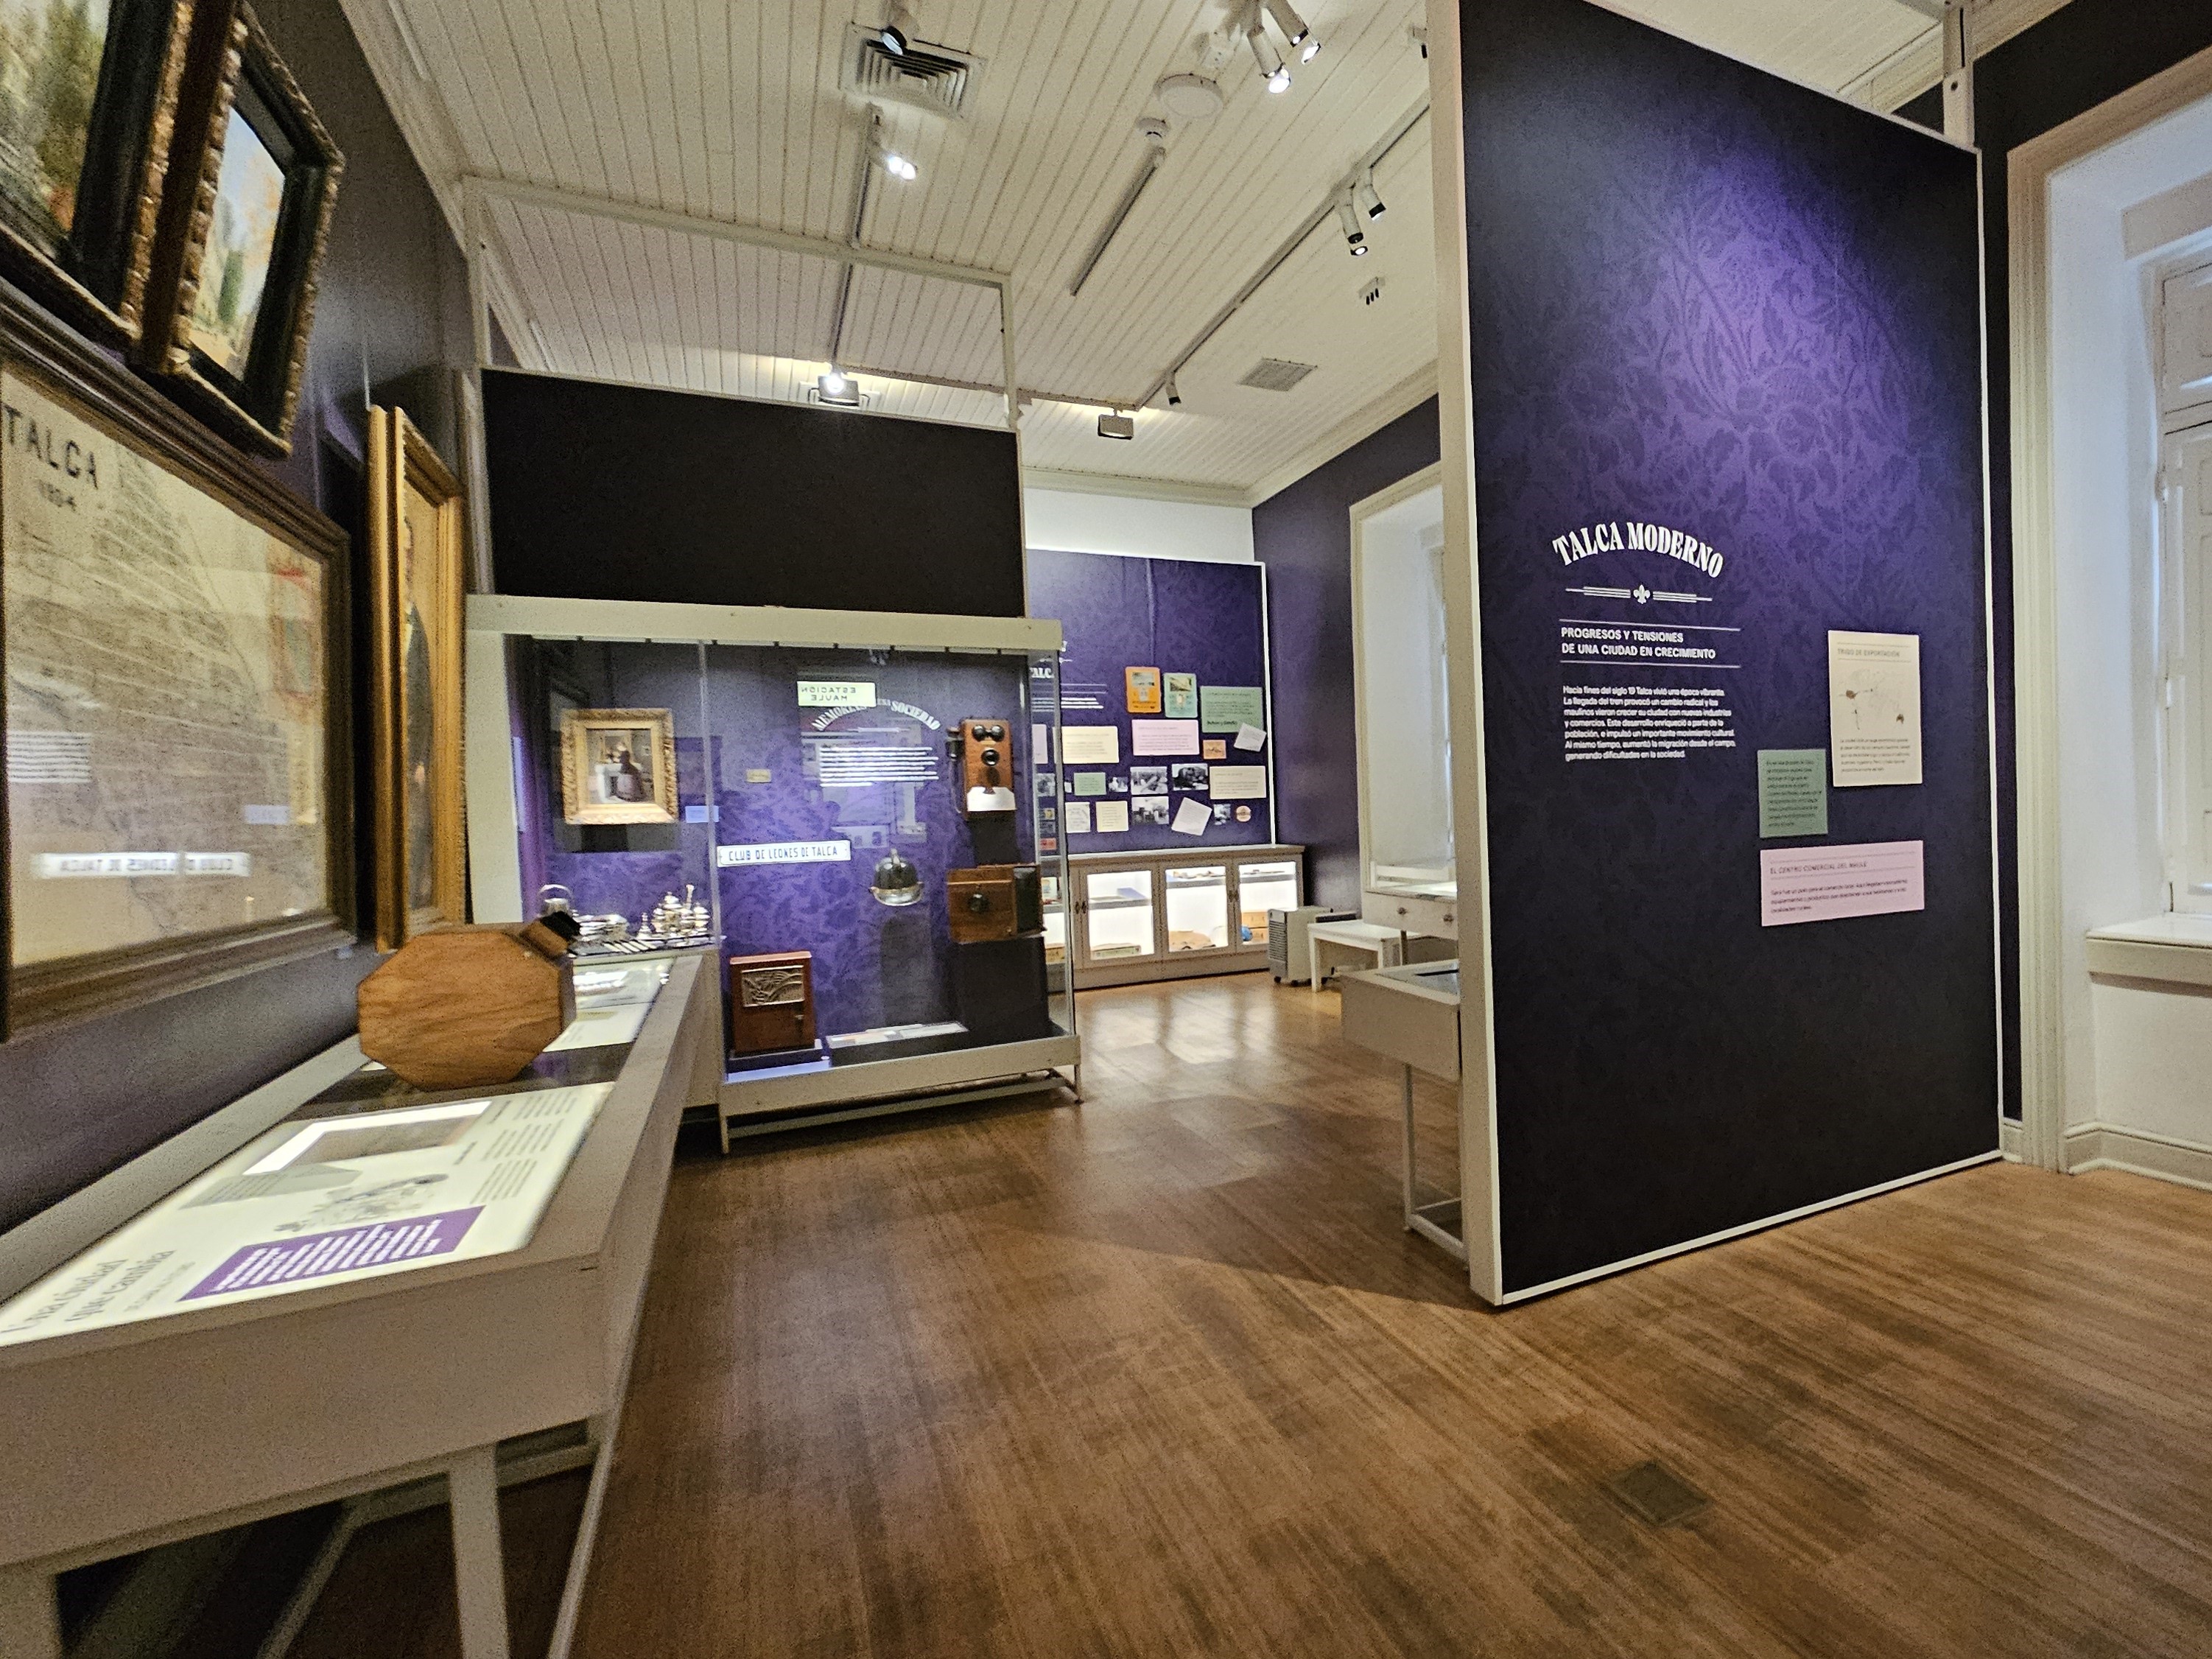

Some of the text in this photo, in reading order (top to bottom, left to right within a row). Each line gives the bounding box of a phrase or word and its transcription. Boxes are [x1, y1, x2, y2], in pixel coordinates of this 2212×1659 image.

[4, 404, 99, 490] TALCA
[1552, 521, 1724, 578] TALCA MODERNO
[1561, 627, 1684, 643] PROGRESOS Y TENSIONES
[1562, 642, 1716, 659] DE UNA CIUDAD EN CRECIMIENTO
[1563, 697, 1572, 705] La
[1598, 697, 1609, 705] del
[891, 700, 941, 730] SOCIEDAD
[728, 846, 838, 861] CLUB DE LEONES DE TALCA
